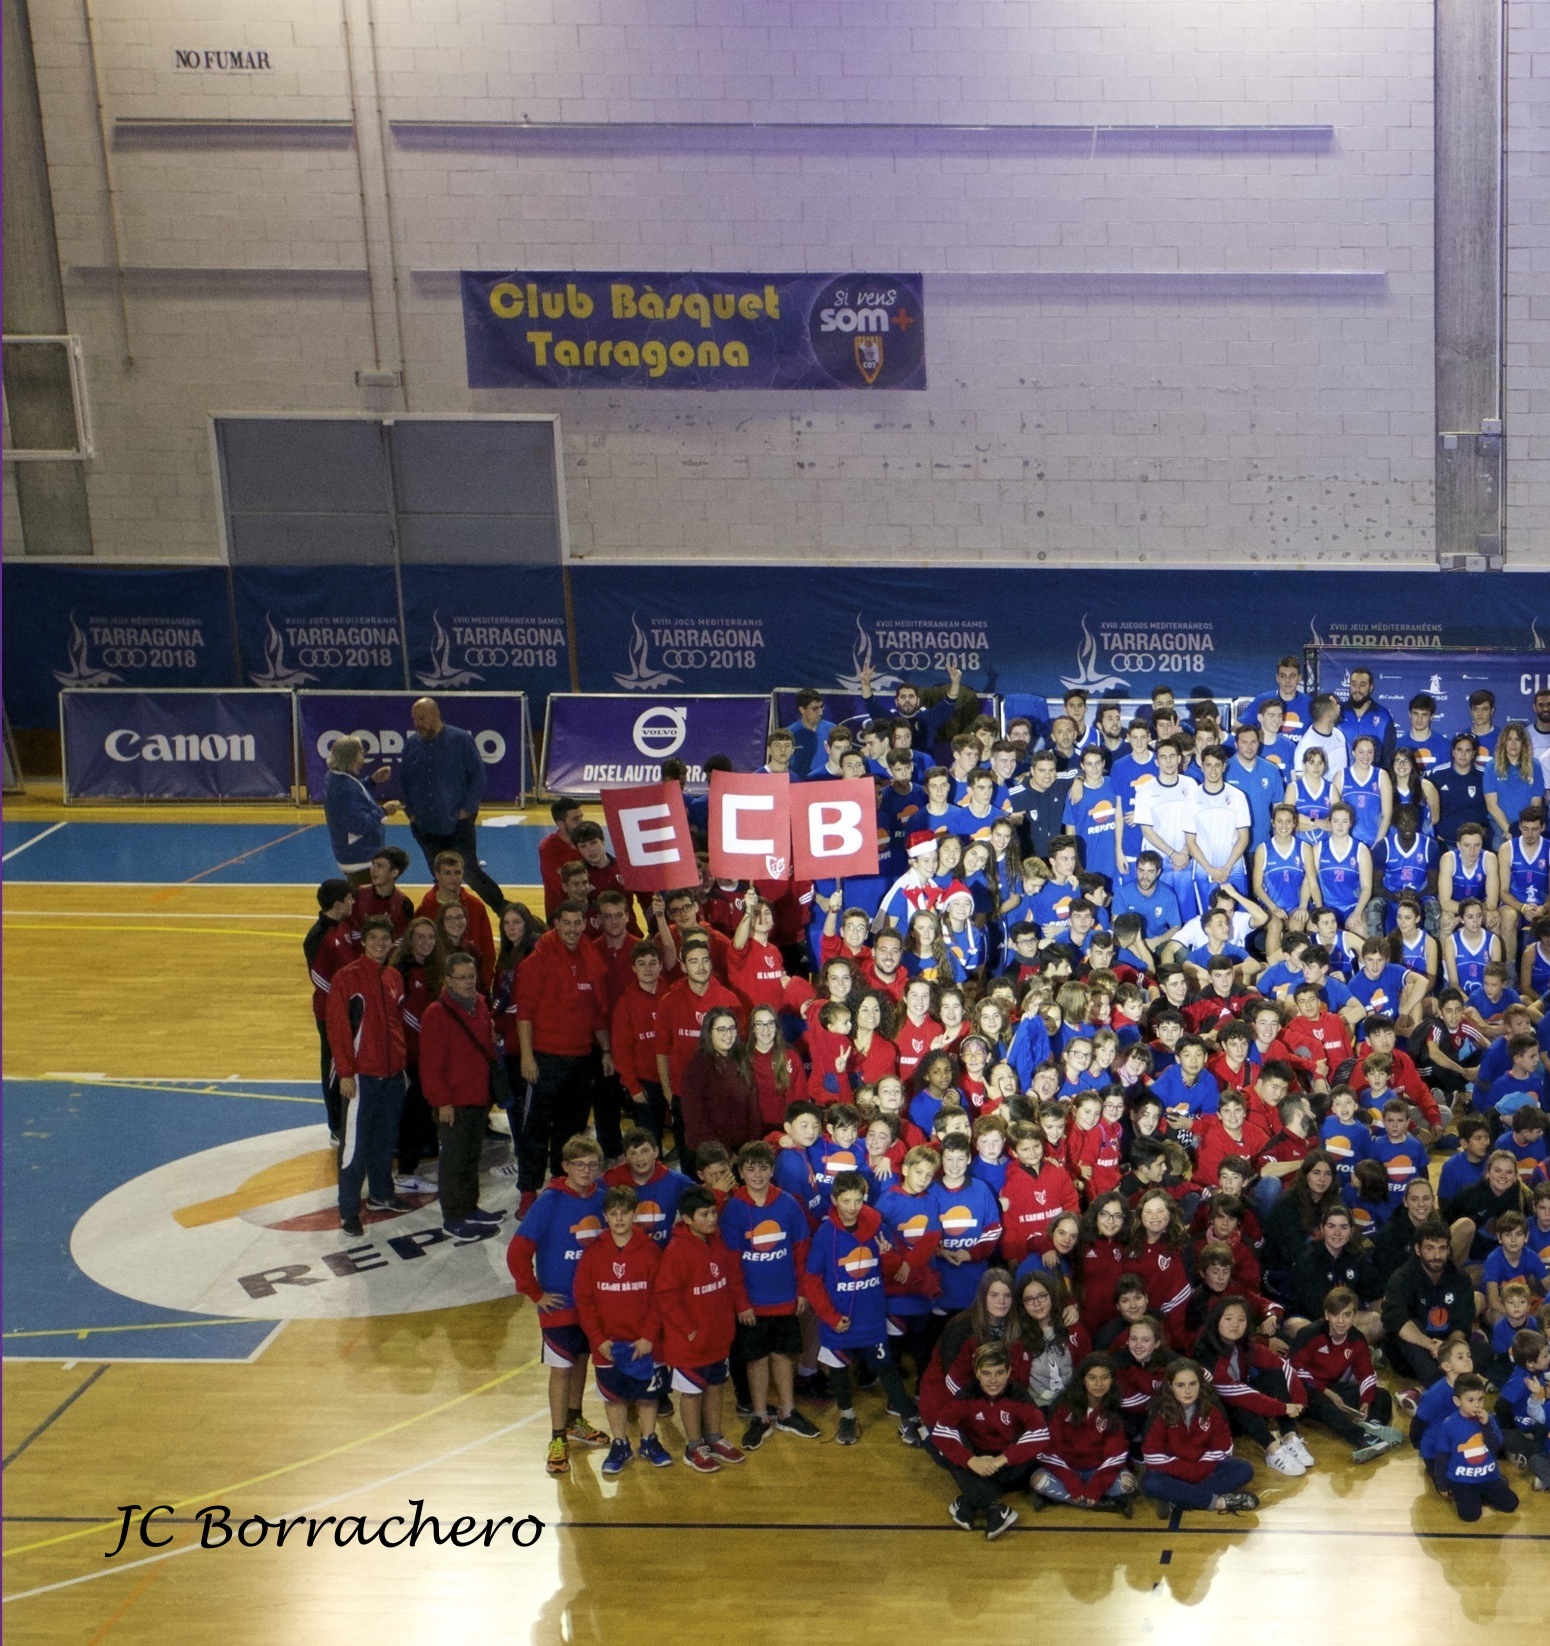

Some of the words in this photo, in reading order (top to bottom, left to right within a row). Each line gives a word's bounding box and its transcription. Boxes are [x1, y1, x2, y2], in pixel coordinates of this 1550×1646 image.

[175, 50, 201, 69] NO
[203, 51, 271, 69] FUMAR
[489, 282, 594, 319] Club
[611, 285, 780, 328] Bàsquet
[526, 331, 749, 377] Tarragona
[1119, 621, 1147, 630] JUEGOS
[1349, 624, 1370, 632] JEUX
[90, 628, 205, 647] TARRAGONA
[285, 628, 400, 646] TARRAGONA
[452, 627, 566, 646] TARRAGONA
[651, 629, 765, 648] TARRAGONA
[875, 631, 989, 649] TARRAGONA
[1100, 632, 1214, 651] TARRAGONA
[150, 650, 196, 667] 2018
[346, 649, 392, 666] 2018
[511, 650, 557, 667] 2018
[710, 651, 756, 668] 2018
[1158, 654, 1205, 673] 2018
[105, 730, 256, 762] Canon
[618, 804, 681, 867] E
[721, 794, 774, 854] C
[808, 801, 863, 857] B
[1088, 822, 1116, 835] REPSO
[837, 1277, 881, 1293] REPSOL
[877, 1343, 885, 1360] 3
[1455, 1461, 1496, 1477] REPSO
